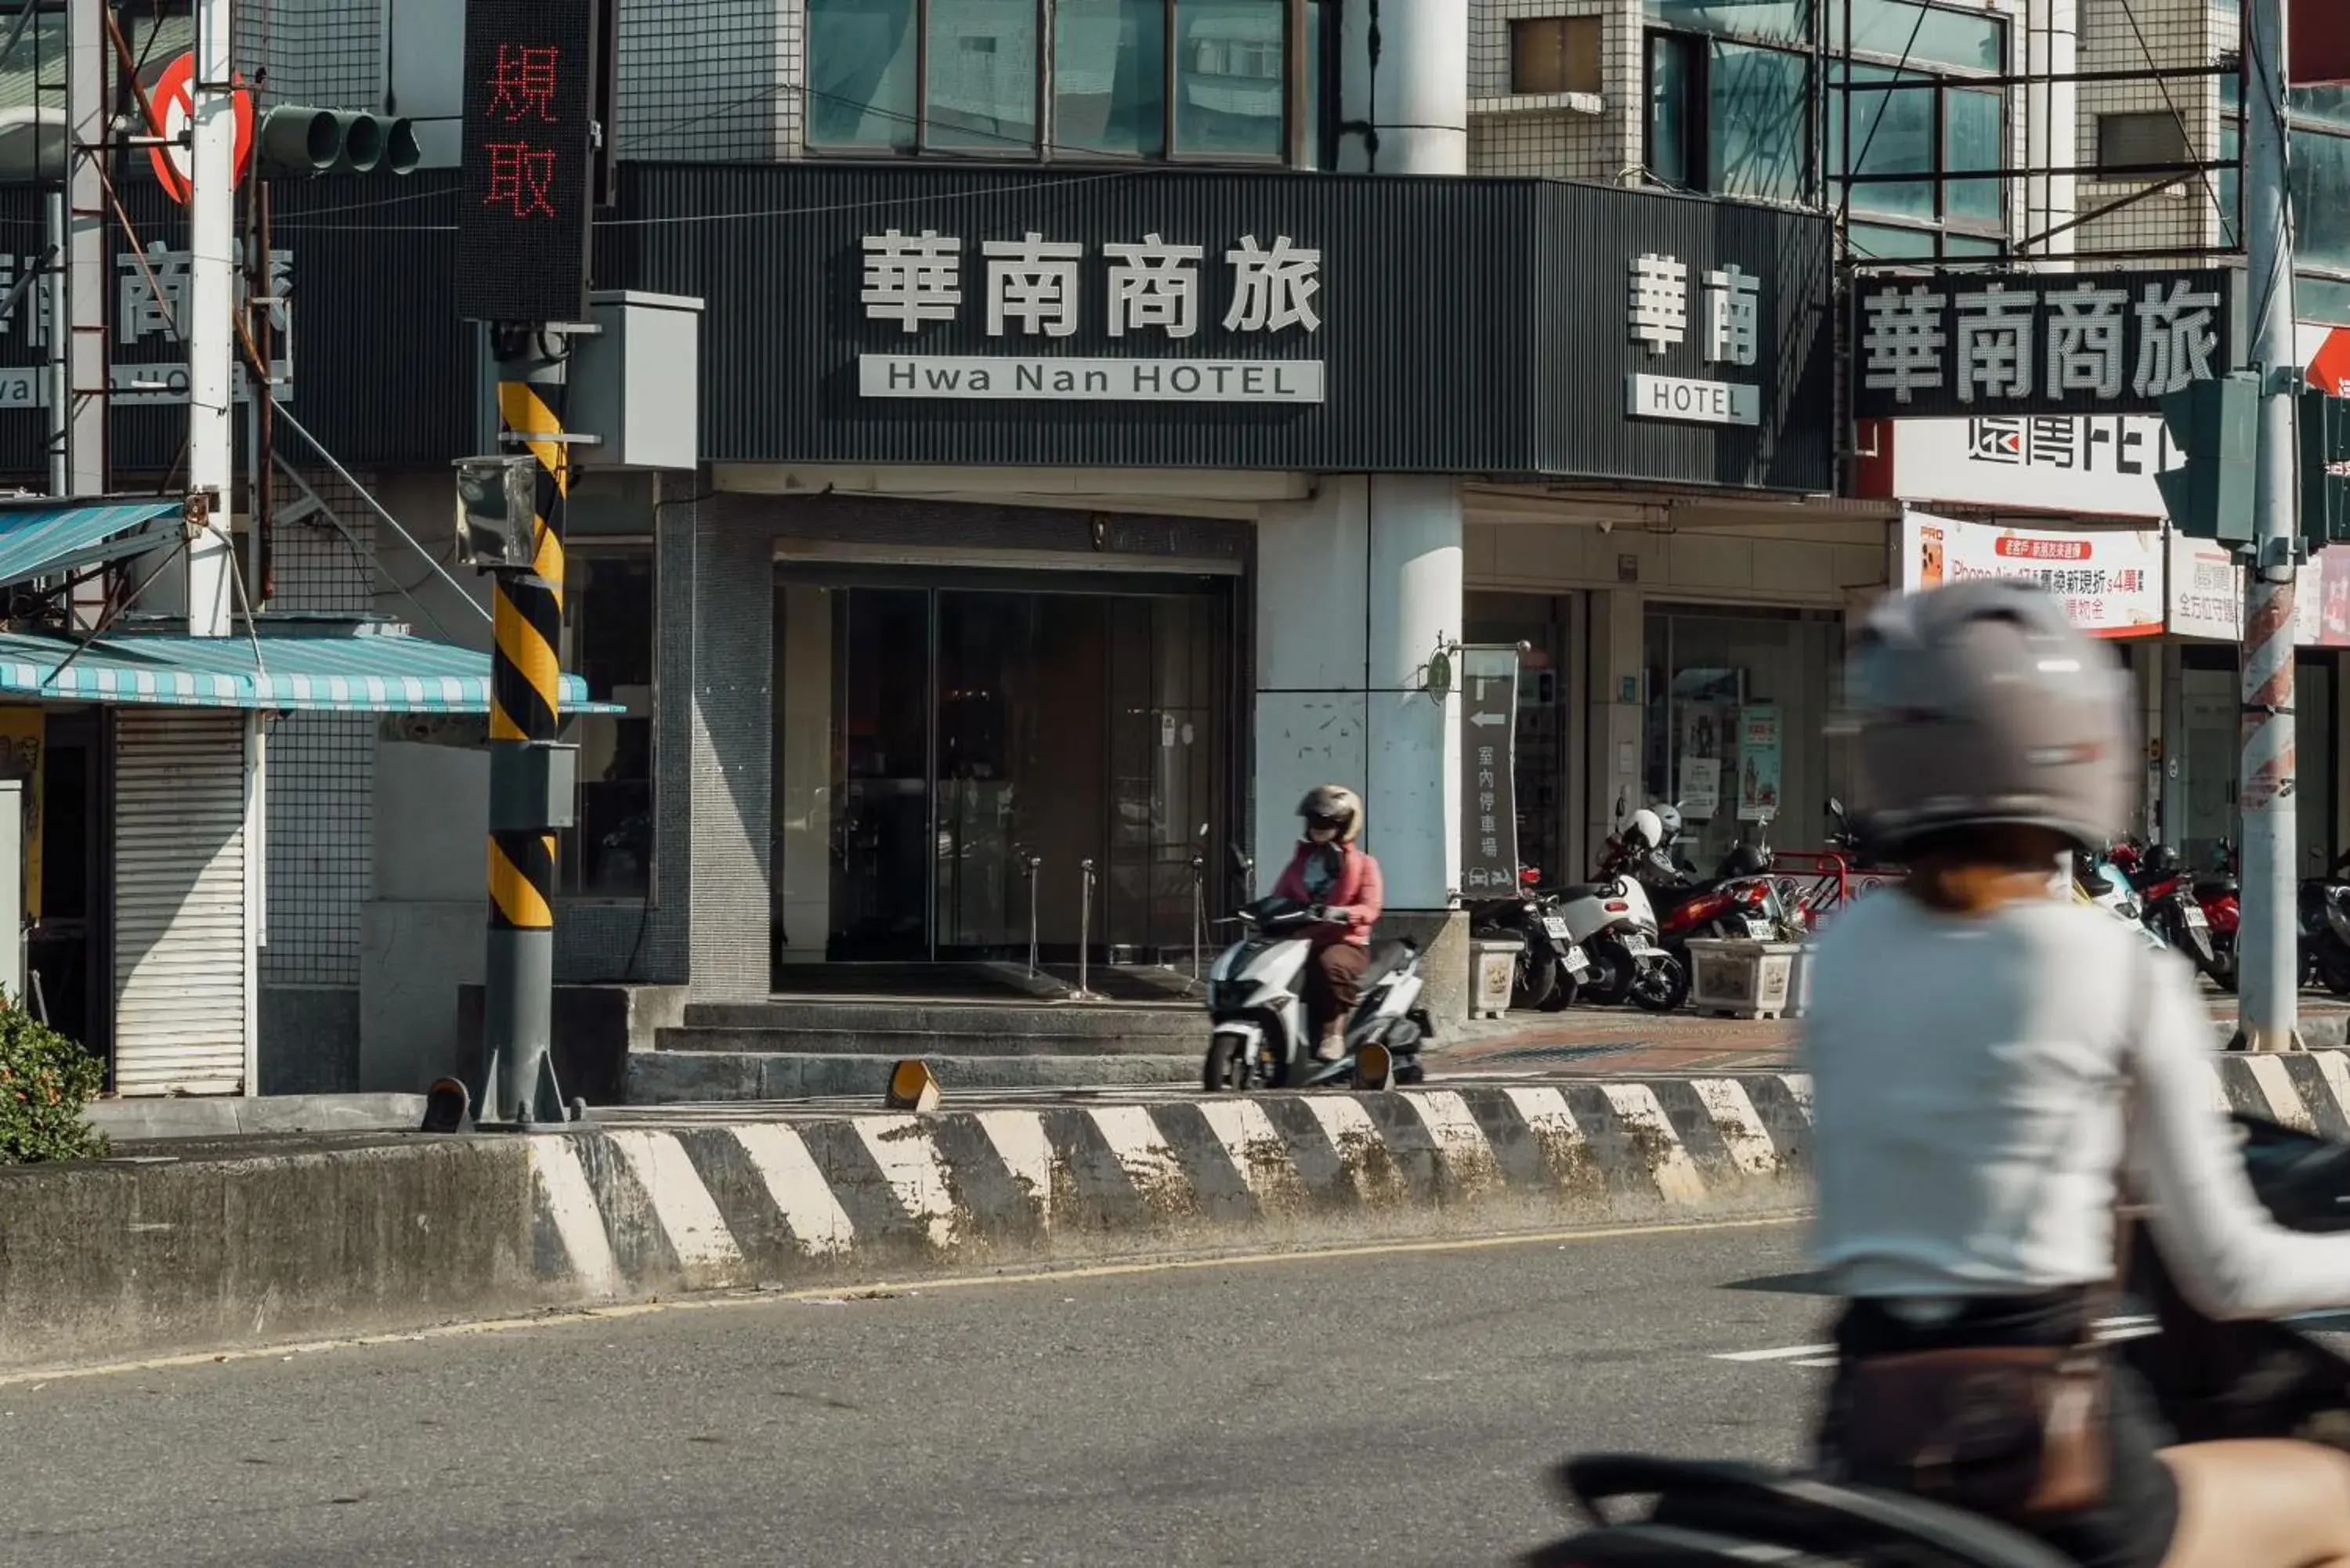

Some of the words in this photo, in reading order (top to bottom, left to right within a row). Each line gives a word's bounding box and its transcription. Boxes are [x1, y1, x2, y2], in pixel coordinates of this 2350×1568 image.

[862, 229, 1321, 338] 華南商旅
[1629, 253, 1760, 366] 華南
[888, 363, 990, 391] Hwa
[1016, 364, 1108, 392] Nan
[1133, 365, 1296, 394] HOTEL
[1864, 280, 2221, 404] 華南商旅
[1654, 382, 1741, 417] HOTEL
[1921, 526, 1943, 541] PRO
[1478, 746, 1499, 858] 室內停車場
